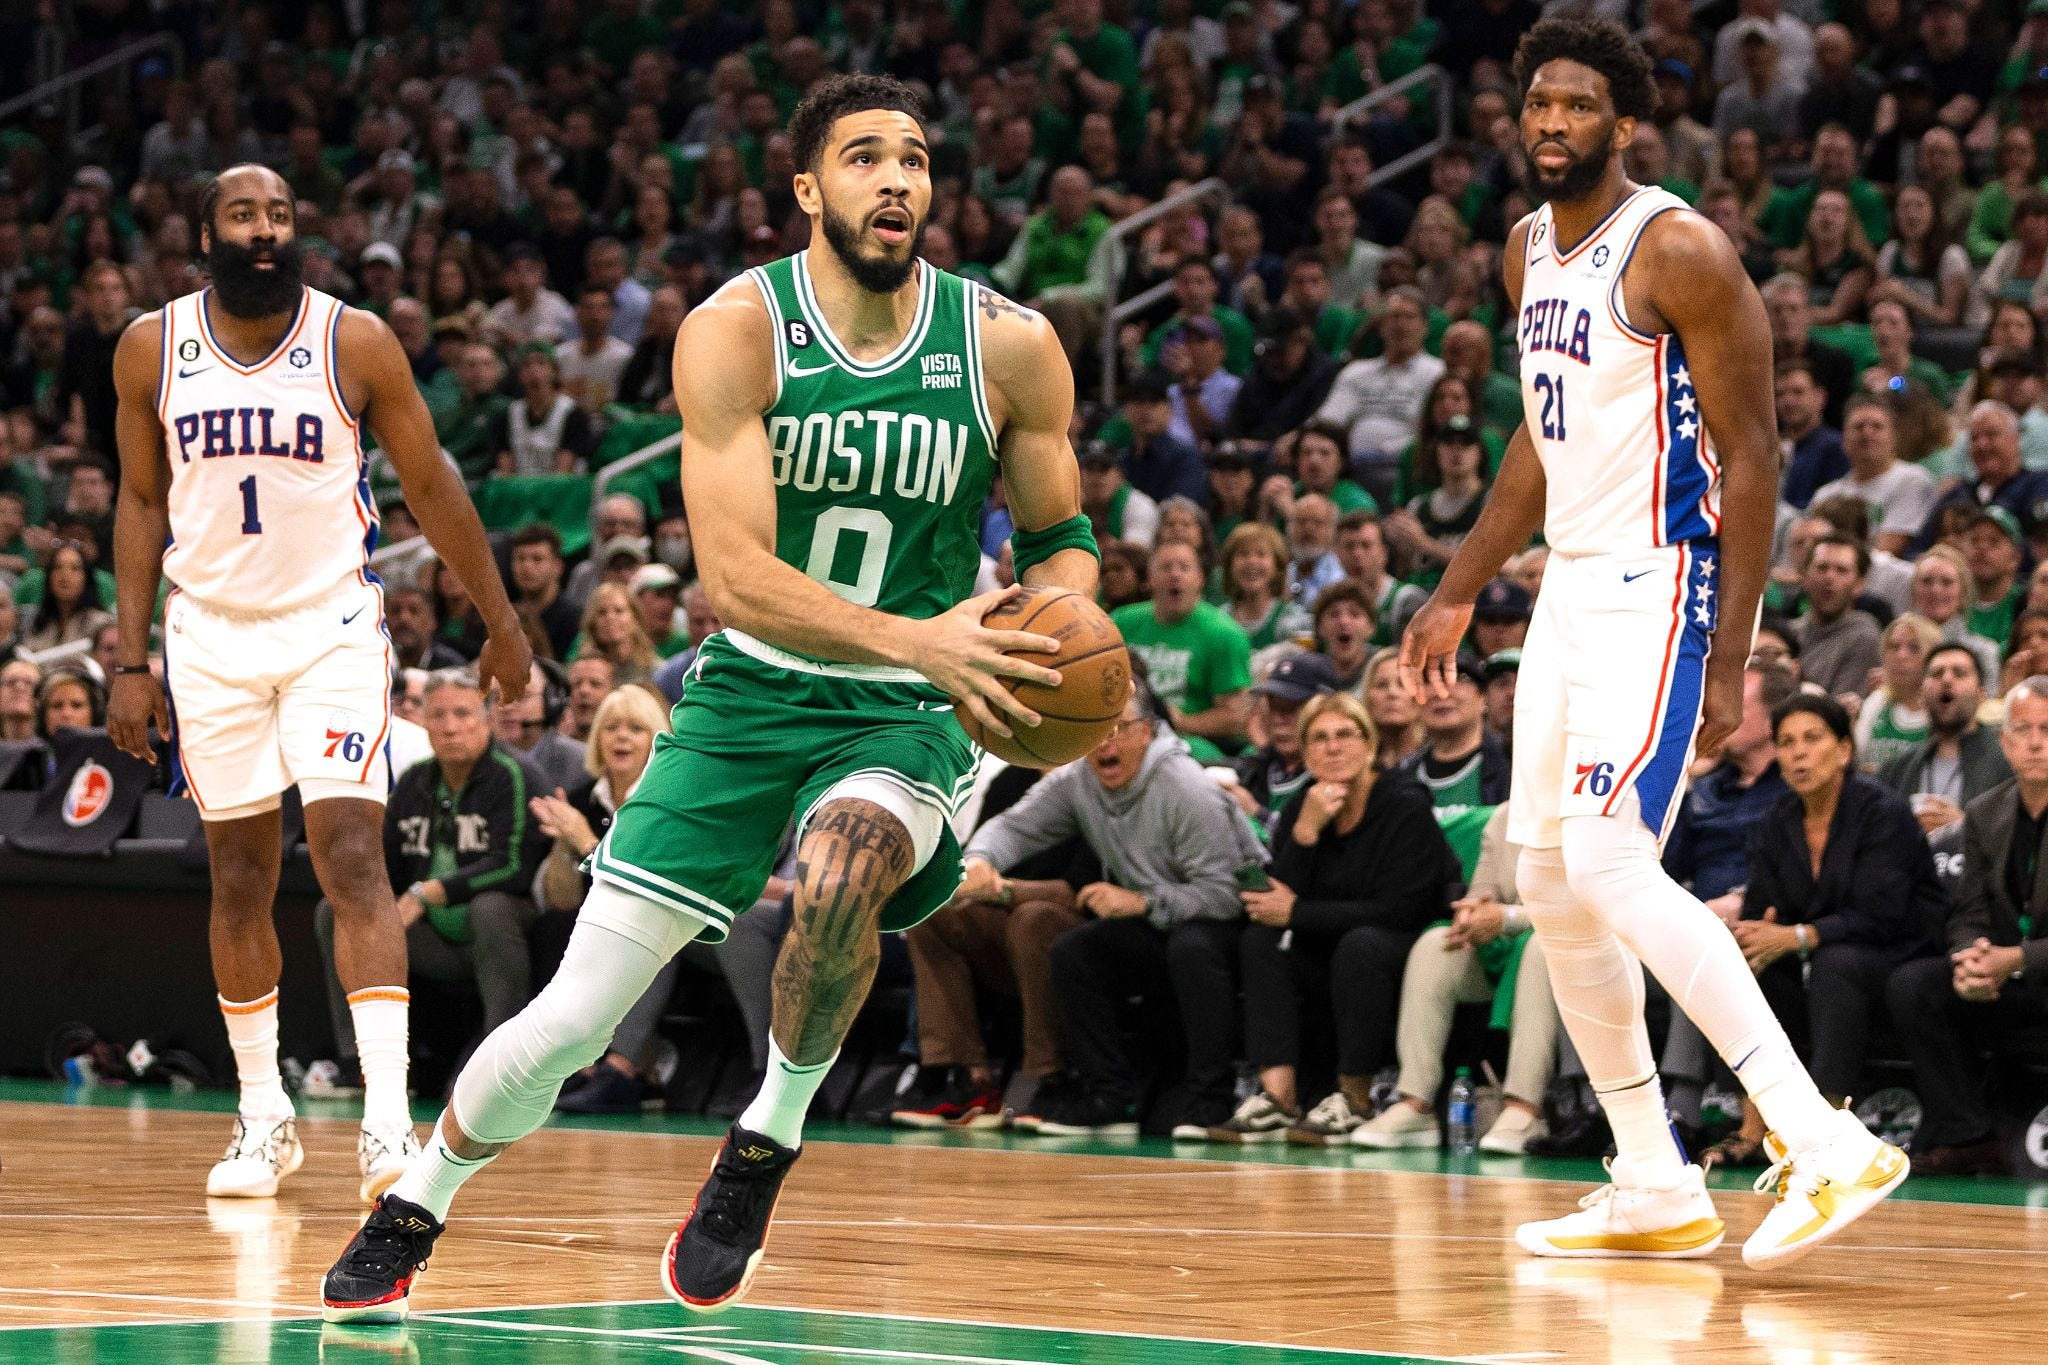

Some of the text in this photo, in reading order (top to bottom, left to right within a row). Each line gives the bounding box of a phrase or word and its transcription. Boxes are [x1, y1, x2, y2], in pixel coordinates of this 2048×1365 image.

[181, 339, 199, 361] 6
[789, 322, 808, 346] 6
[1519, 298, 1592, 367] PHILA
[920, 353, 962, 374] VISTA
[922, 373, 962, 389] PRINT
[1534, 372, 1566, 442] 21
[174, 407, 324, 463] PHILA
[768, 410, 969, 506] BOSTON
[239, 474, 262, 535] 1
[805, 505, 894, 608] 0
[323, 727, 365, 763] 76
[1573, 761, 1615, 797] 76
